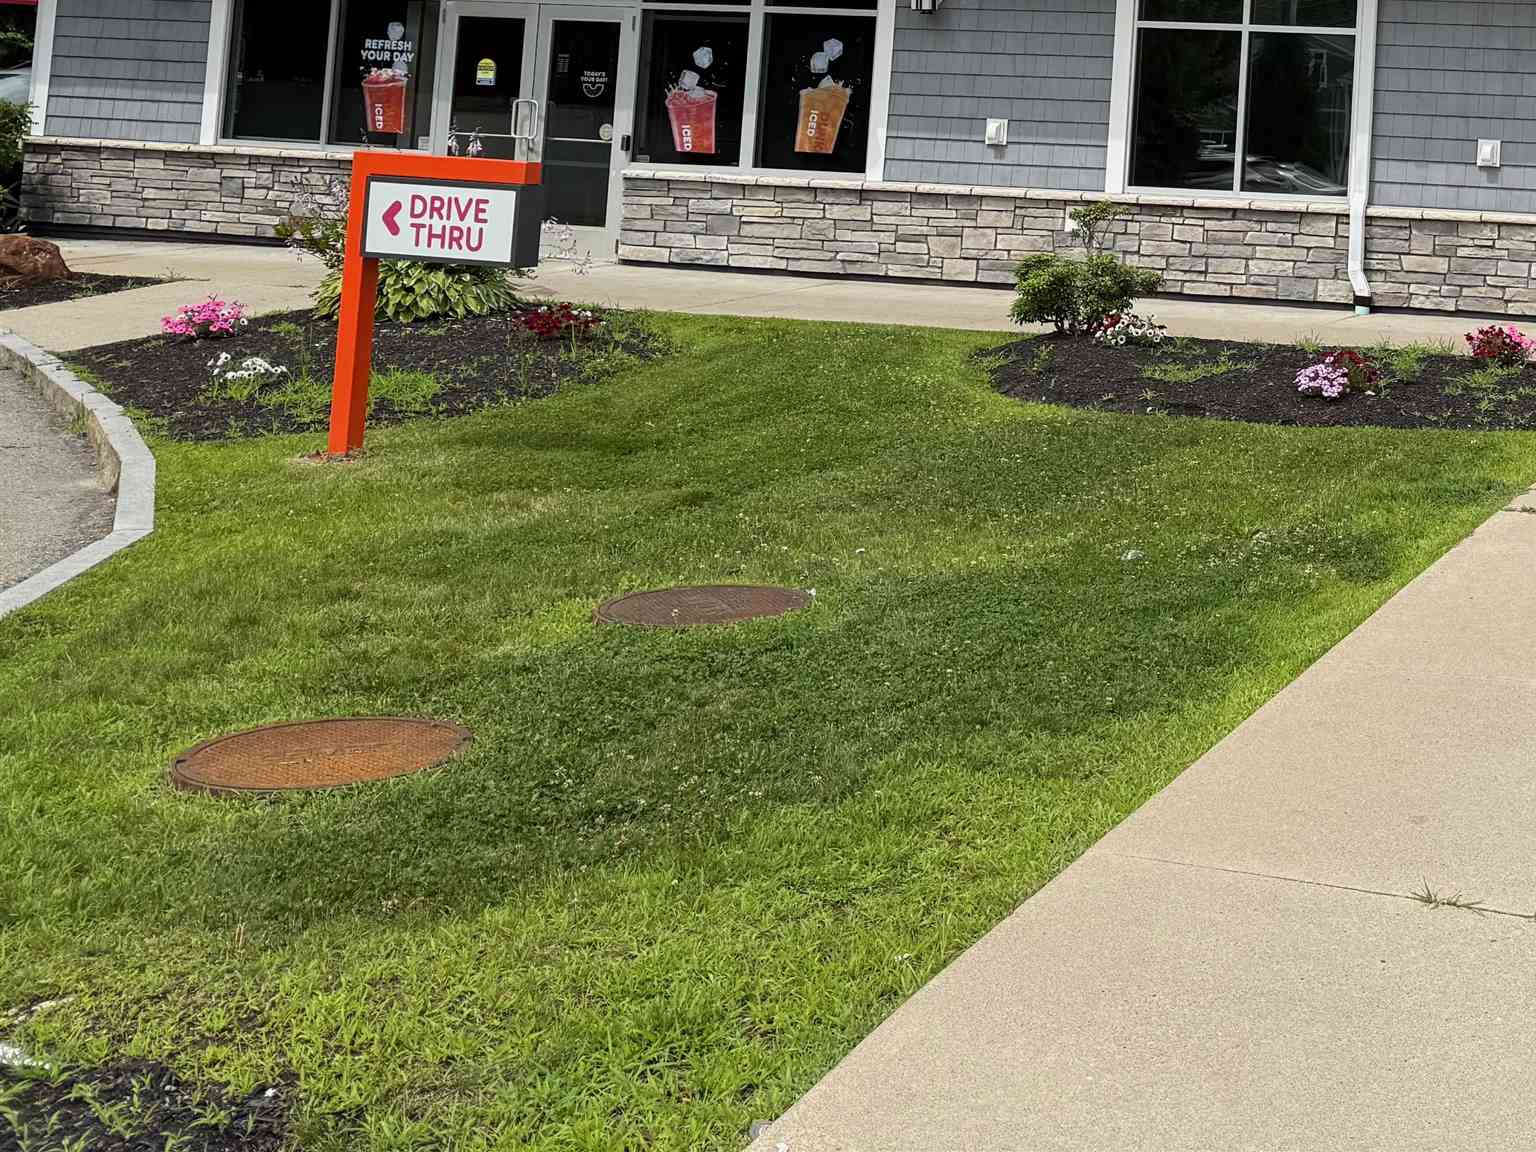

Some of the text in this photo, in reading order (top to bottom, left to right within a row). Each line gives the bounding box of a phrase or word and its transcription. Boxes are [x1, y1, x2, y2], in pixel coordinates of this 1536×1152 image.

[361, 50, 414, 62] YOUR DAY
[365, 39, 412, 51] REFRESH
[375, 103, 384, 129] ICED
[807, 110, 819, 137] ICED
[681, 124, 692, 152] ICED
[409, 194, 490, 224] DRIVE
[410, 223, 484, 252] THRU
